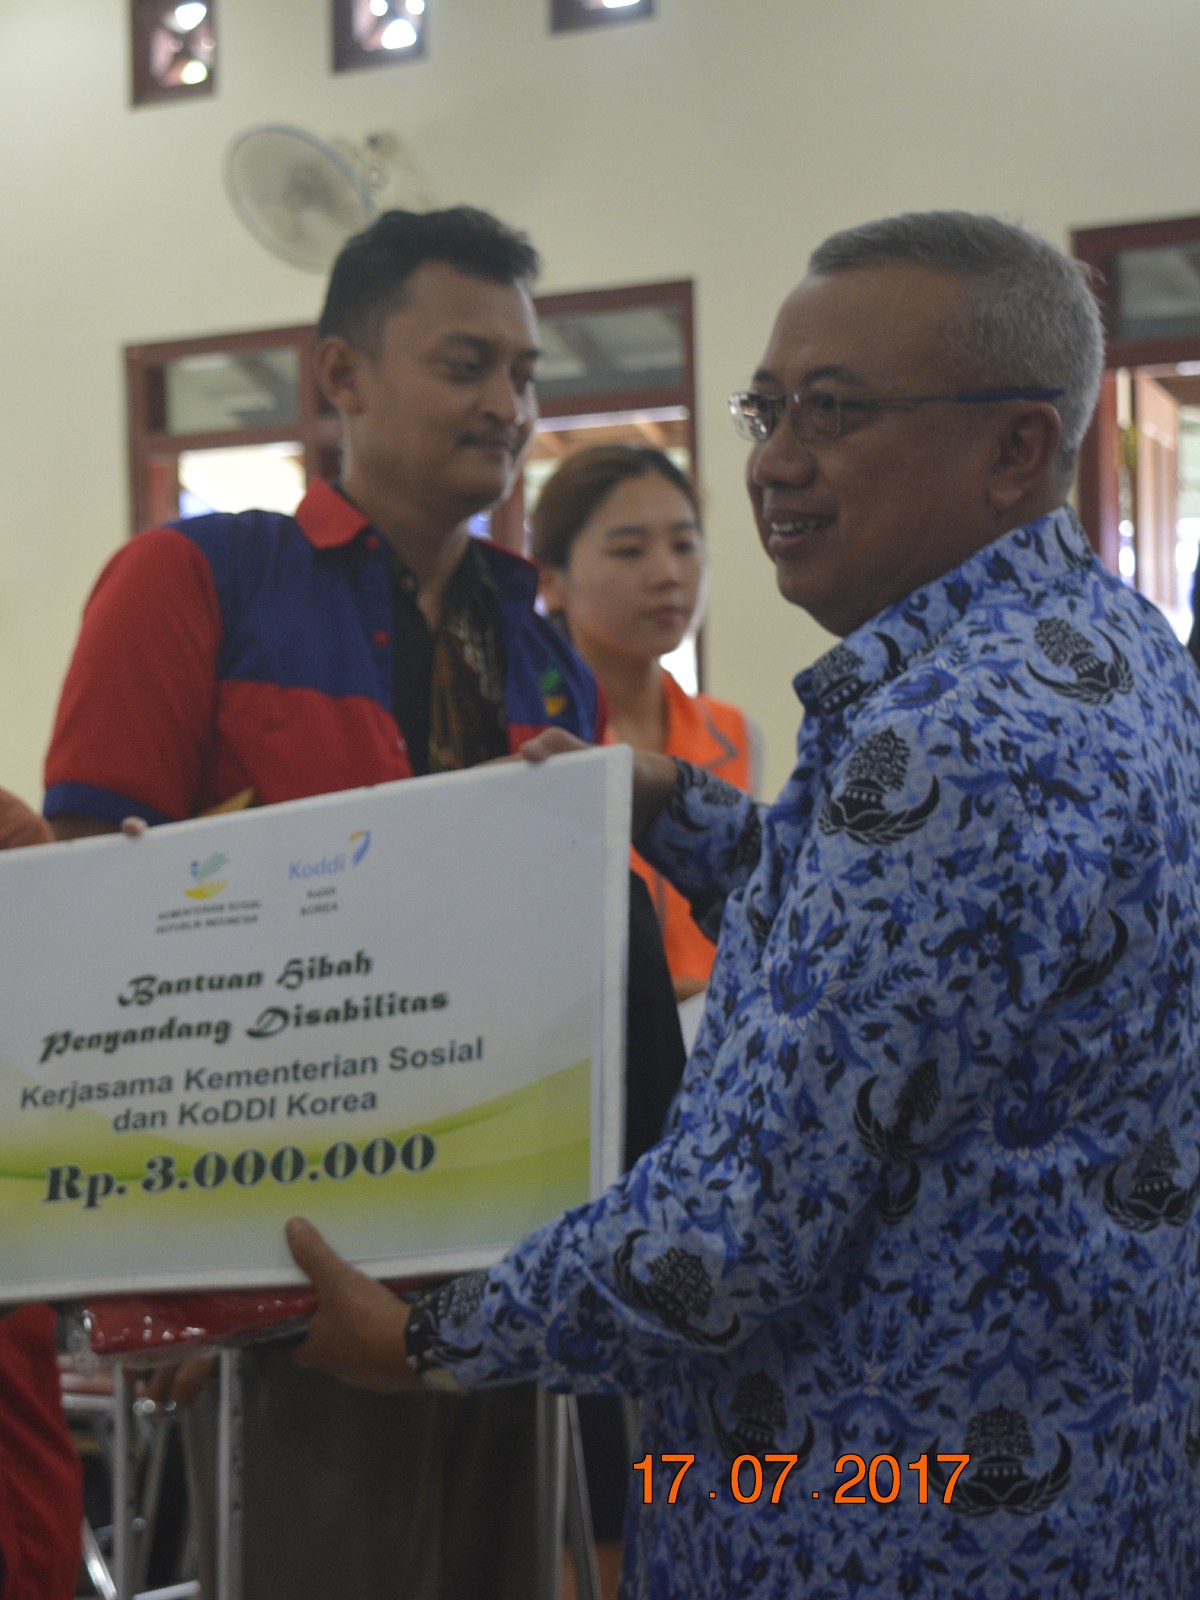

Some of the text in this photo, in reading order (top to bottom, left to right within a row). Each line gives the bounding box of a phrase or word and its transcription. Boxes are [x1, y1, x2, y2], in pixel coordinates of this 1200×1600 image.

[288, 853, 346, 880] Koddi
[117, 949, 373, 1008] Bantuan Hibah
[38, 992, 448, 1065] Penyandang Disabilitas
[20, 1036, 483, 1110] Kerjasama Kementerian Sosial
[113, 1091, 377, 1132] dan KoDDI Korea
[44, 1131, 435, 1209] Rp. 3.000.000
